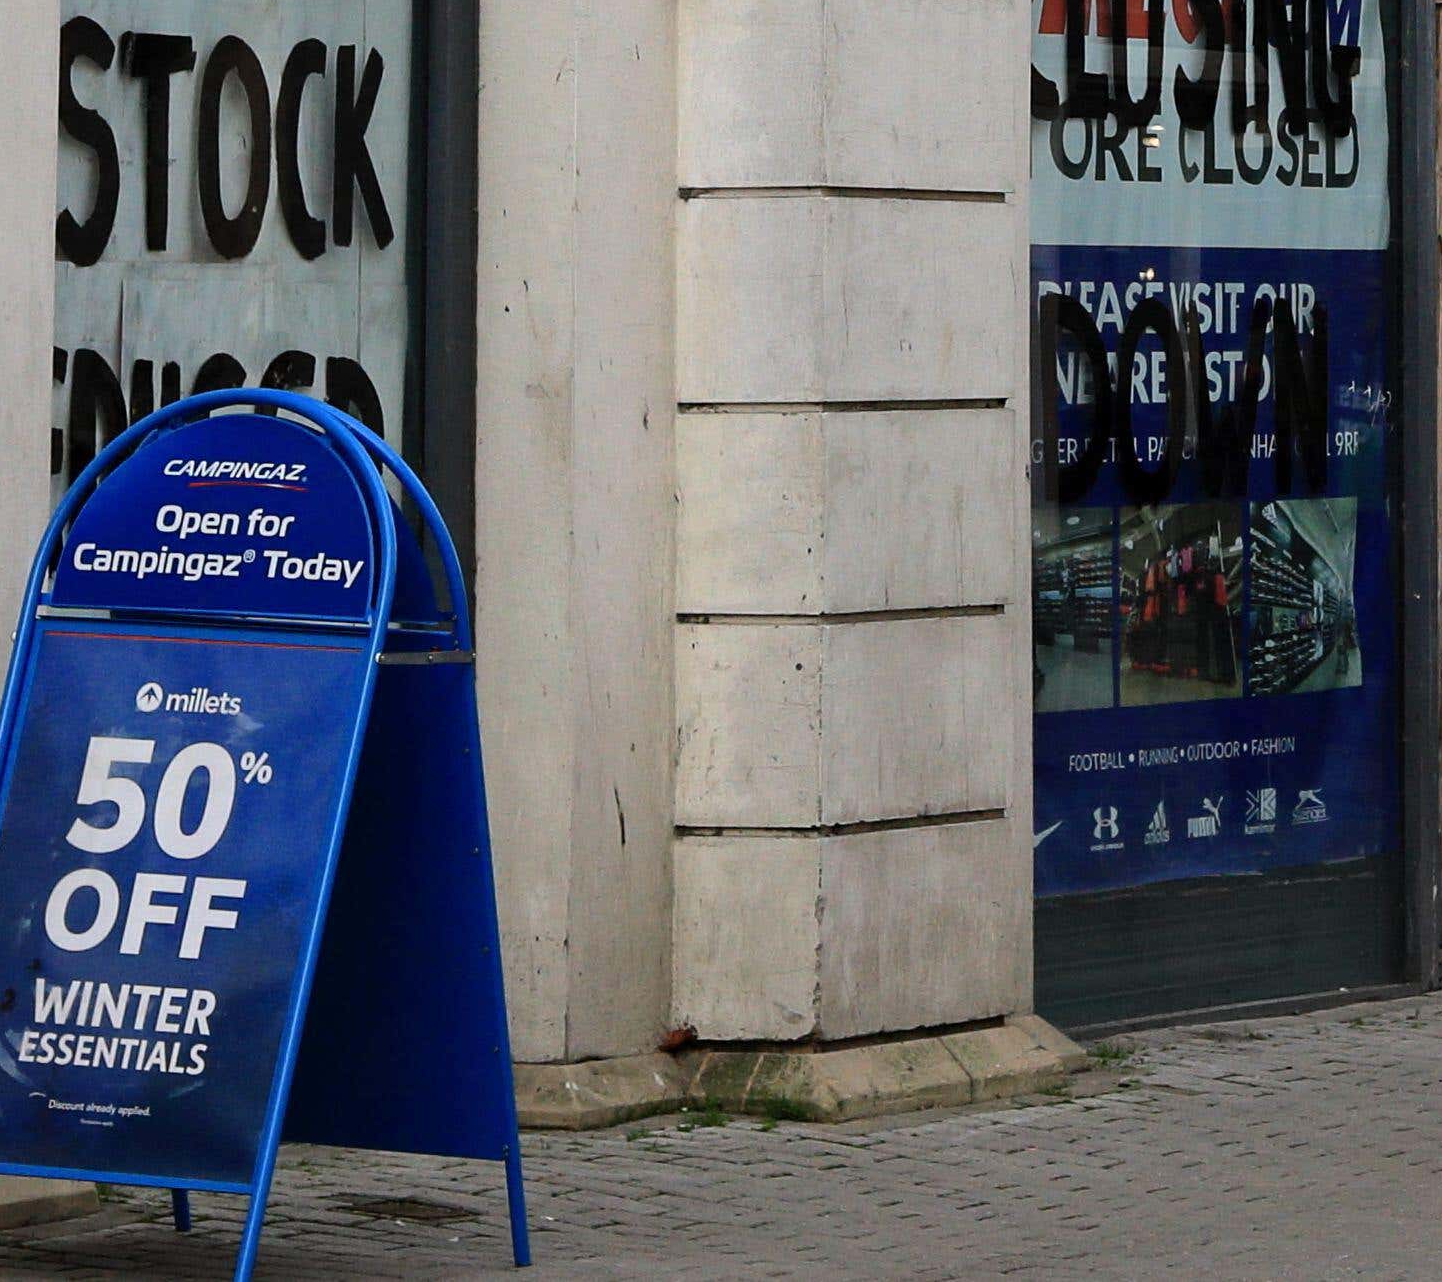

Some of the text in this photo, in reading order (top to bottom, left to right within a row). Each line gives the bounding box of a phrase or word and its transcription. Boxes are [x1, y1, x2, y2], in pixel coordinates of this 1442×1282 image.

[54, 15, 395, 267] STOCK
[156, 504, 295, 540] Open for
[264, 549, 364, 589] Today
[166, 685, 242, 717] millets
[1069, 737, 1296, 772] FOOTBALL RUNNING OUTDOOR FASHION
[66, 736, 273, 860] 50%
[44, 868, 248, 960] OFF
[33, 978, 218, 1037] WINTER
[18, 1031, 207, 1076] ESSENTIALS
[48, 1099, 85, 1112] Discount
[85, 1102, 116, 1115] already
